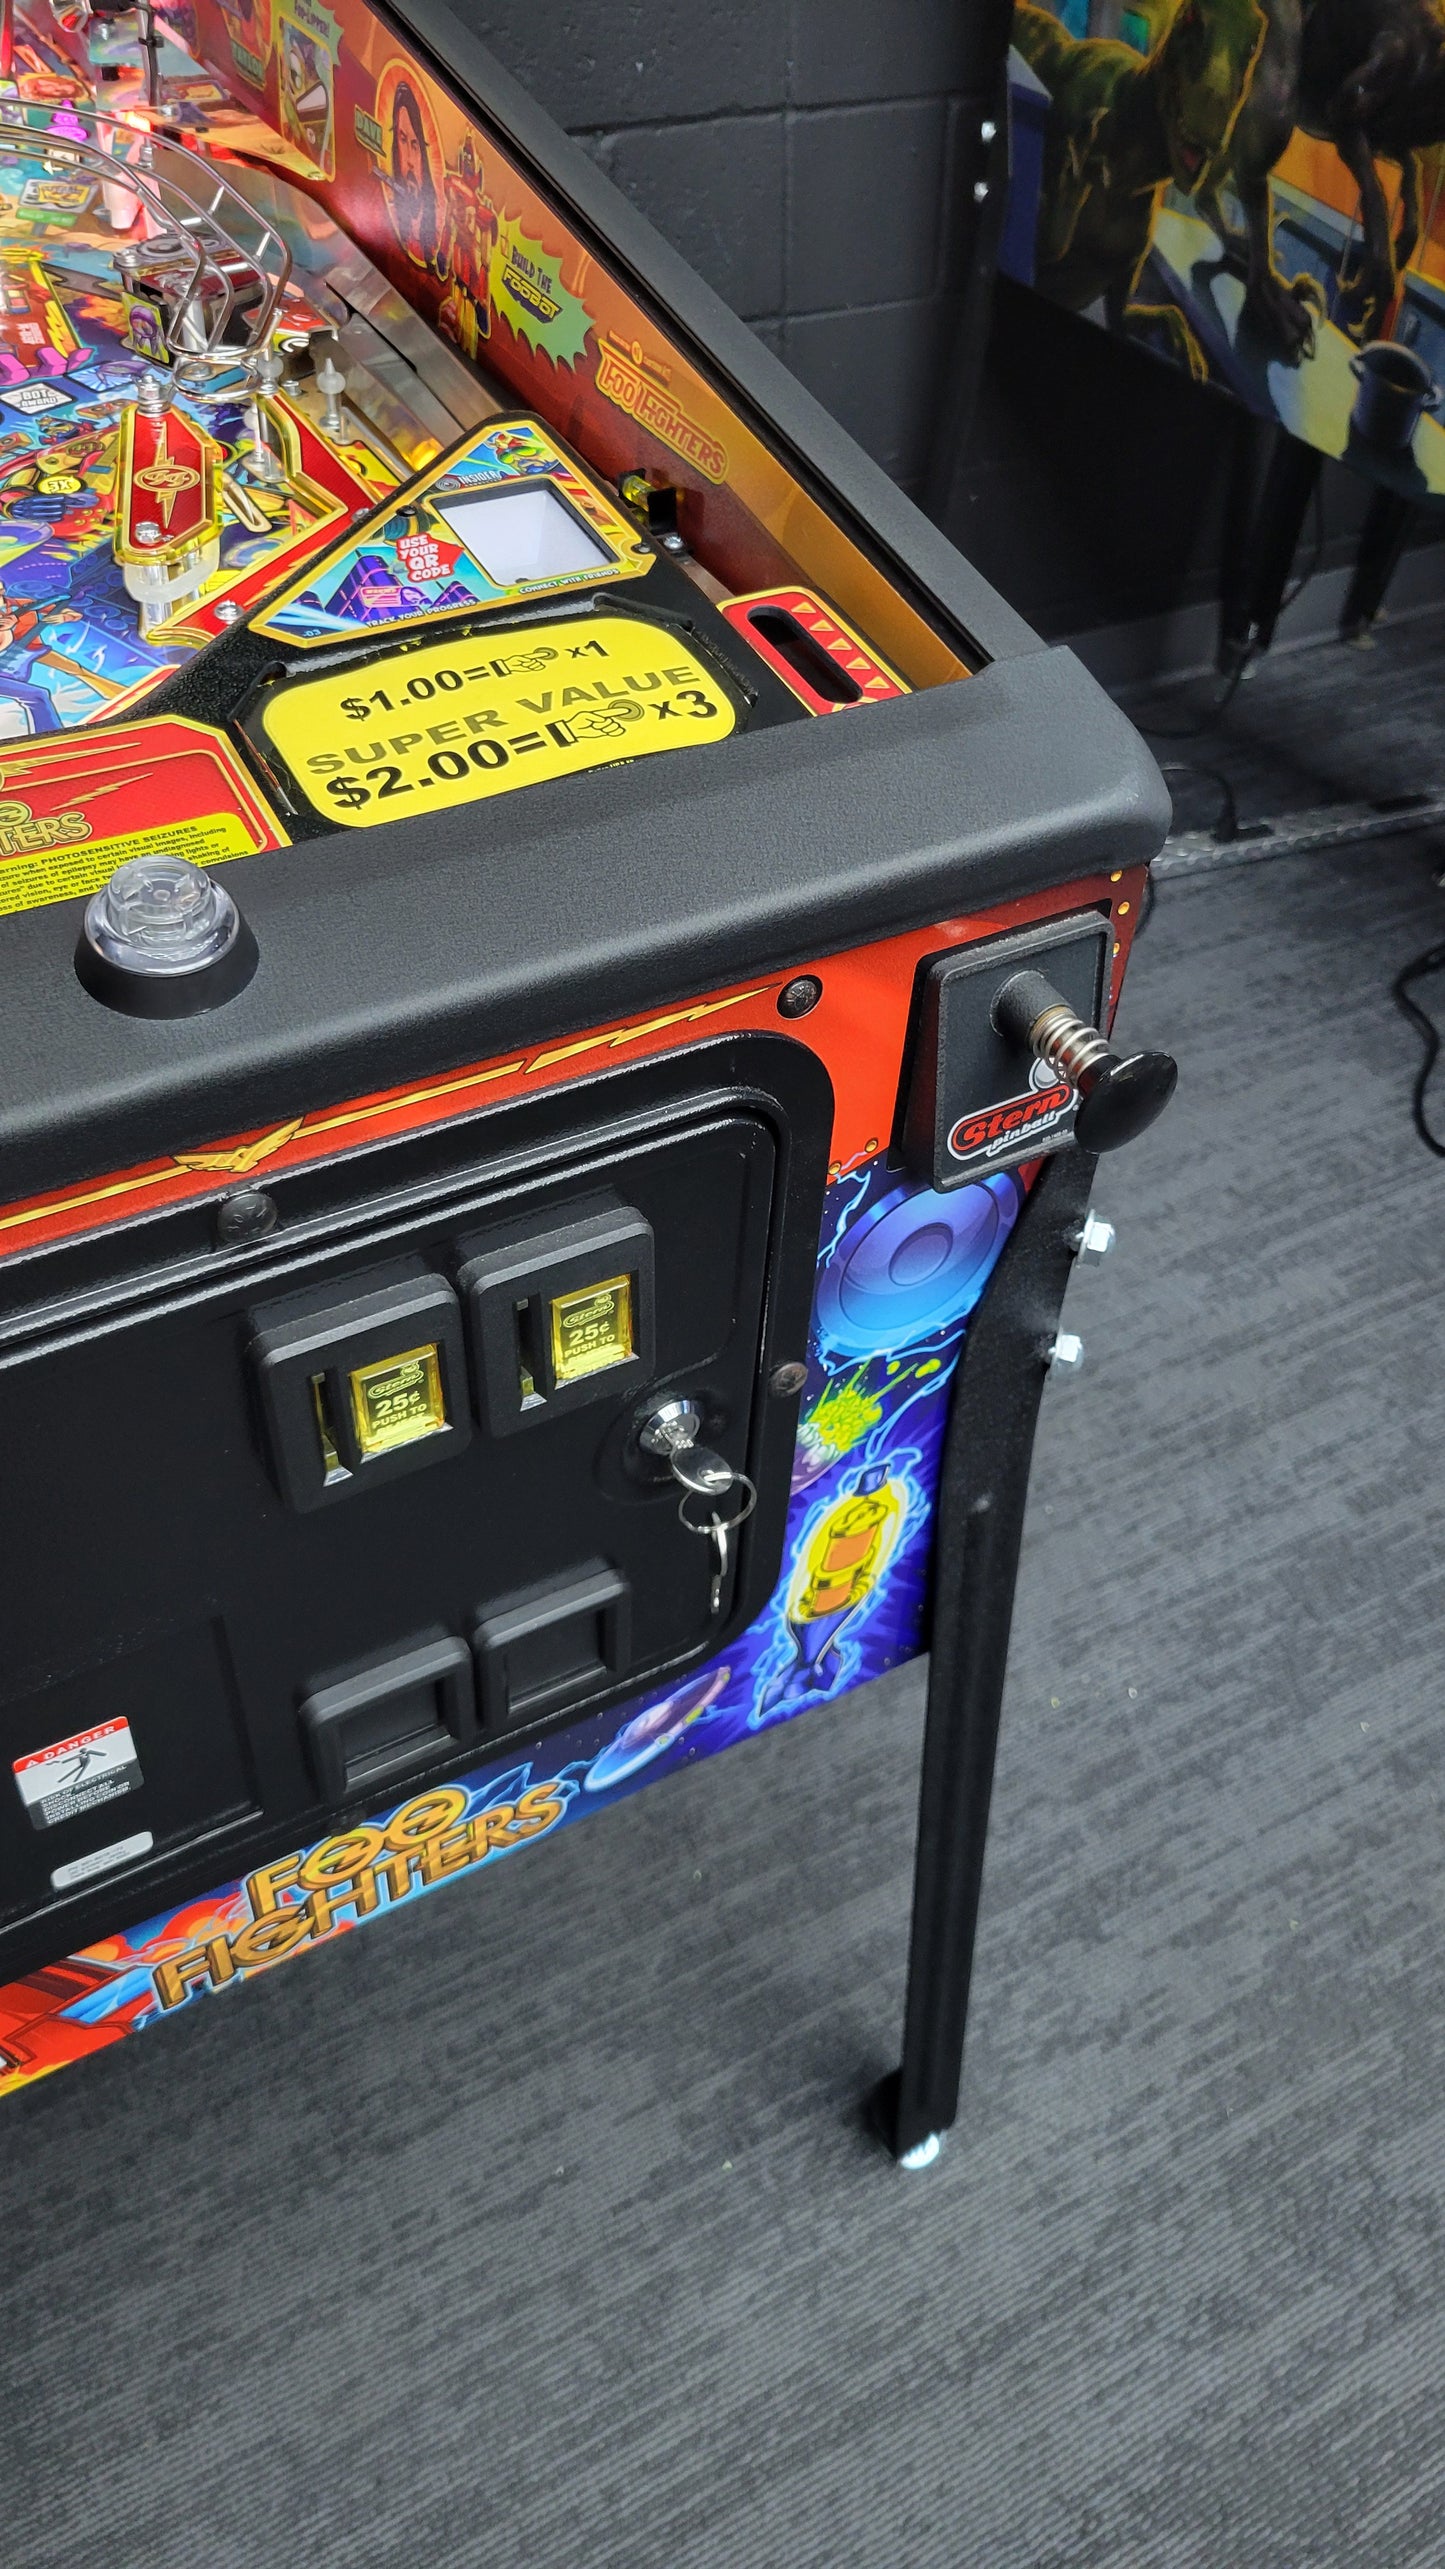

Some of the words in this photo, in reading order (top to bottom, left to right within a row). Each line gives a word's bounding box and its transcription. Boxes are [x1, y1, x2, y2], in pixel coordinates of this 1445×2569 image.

[356, 111, 382, 146] DAVE
[511, 245, 535, 278] BUILD
[537, 267, 552, 294] THE
[503, 266, 560, 319] FOOBOT
[21, 397, 57, 407] AWARD
[22, 390, 48, 400] BOT
[635, 382, 725, 476] FIGHTERS
[459, 470, 498, 485] INSIDER
[399, 543, 439, 560] YOUR
[400, 534, 428, 549] USE
[409, 554, 439, 570] QR
[411, 564, 450, 581] CODE
[519, 581, 558, 594] CONNECT
[559, 576, 582, 586] WITH
[584, 568, 620, 582] FRIENDS
[367, 617, 395, 629] TRACK
[399, 610, 424, 621] YOUR
[428, 599, 476, 614] PROGRESS
[565, 640, 610, 658] x1
[648, 690, 719, 720] x3
[307, 709, 508, 775] SUPER
[516, 666, 702, 714] VALUE
[0, 862, 38, 874] arning:
[41, 839, 140, 864] PHOTOSENSITIVE
[143, 826, 197, 843] SEIZURES
[12, 875, 48, 885] seizures
[62, 863, 97, 874] epilepsy
[99, 858, 117, 867] may
[153, 838, 205, 854] undiagnosed
[22, 867, 47, 876] when
[48, 859, 84, 871] exposed
[97, 850, 128, 860] certain
[129, 843, 153, 852] visual
[186, 846, 209, 855] lights
[188, 851, 221, 861] shaking
[201, 851, 248, 865] convulsions
[57, 873, 88, 882] certain
[90, 866, 115, 875] visual
[79, 885, 94, 893] and
[963, 1093, 1061, 1145] Stern
[992, 1111, 1056, 1149] pinball
[564, 1341, 597, 1359] PUSH
[599, 1334, 615, 1345] TO
[569, 1321, 610, 1347] 25¢
[372, 1410, 407, 1429] PUSH
[409, 1403, 427, 1415] TO
[375, 1391, 421, 1418] 25¢
[44, 1725, 116, 1761] DANGER
[246, 1785, 469, 1920] FOO
[152, 1782, 568, 2011] FIGHTERS
